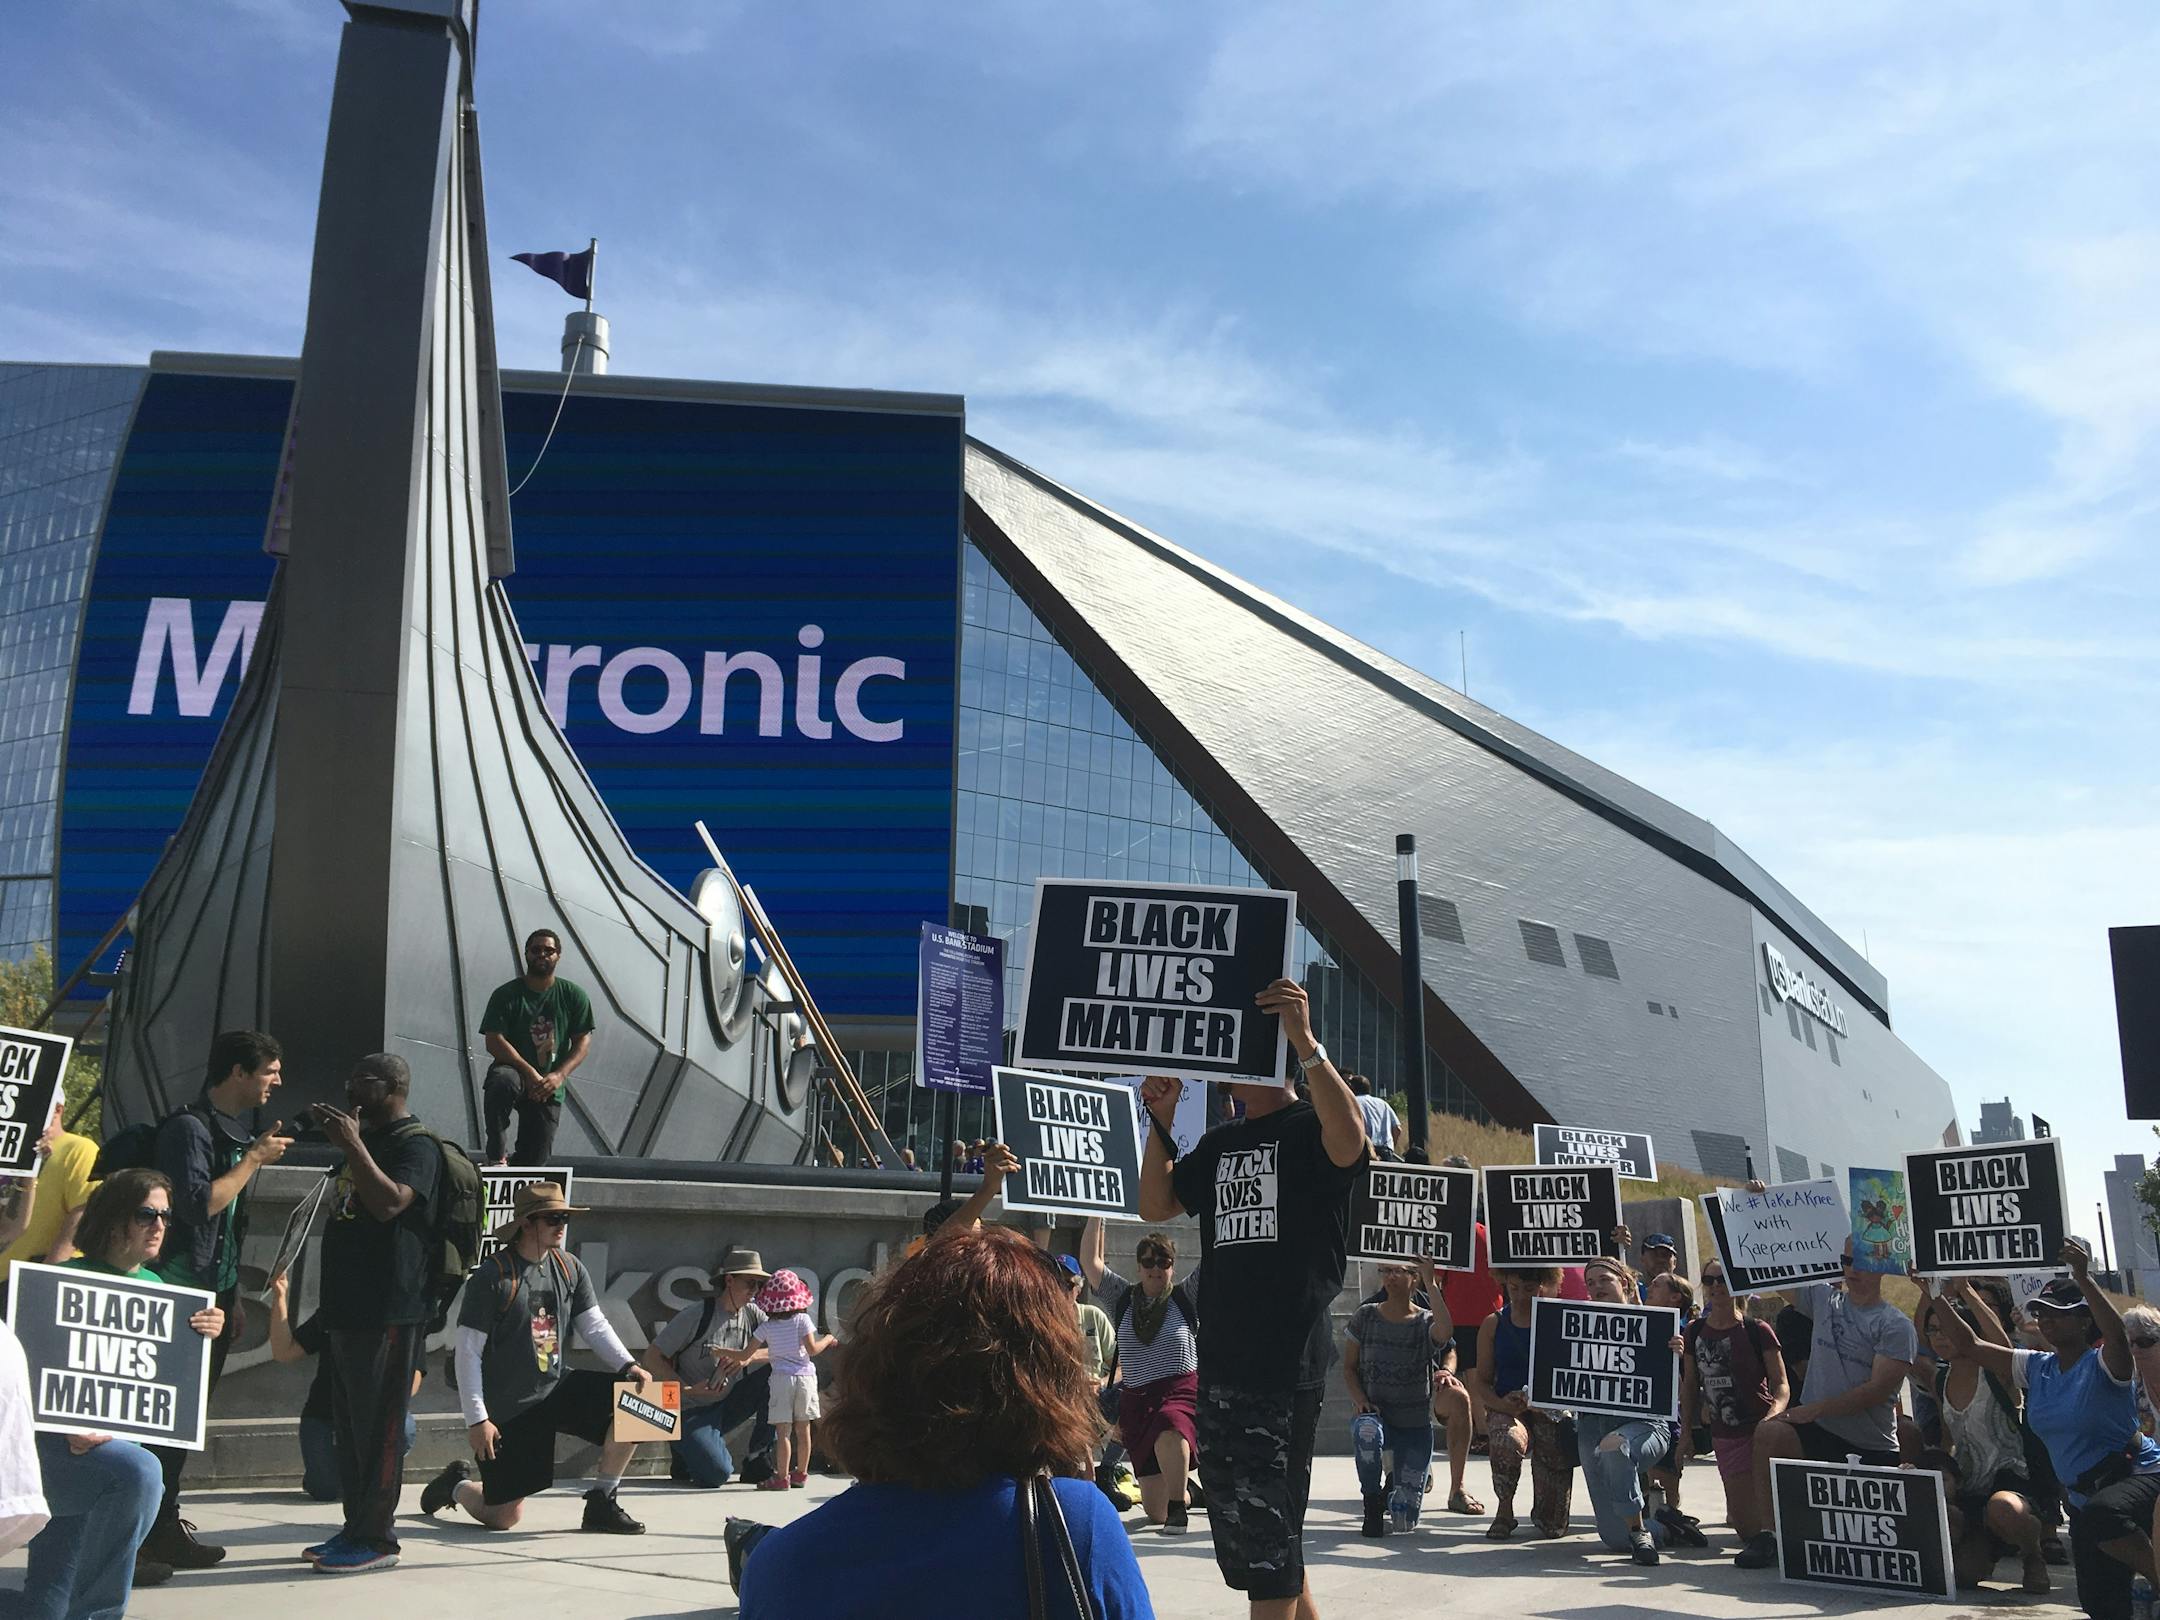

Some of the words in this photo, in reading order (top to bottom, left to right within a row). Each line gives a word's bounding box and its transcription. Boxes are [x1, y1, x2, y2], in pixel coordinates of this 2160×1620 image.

[127, 597, 906, 743] Mronic
[1089, 900, 1232, 951] BLACK
[931, 932, 944, 944] U.S.
[962, 940, 995, 955] STADIUM
[1096, 951, 1214, 1003] LIVES
[1064, 1002, 1236, 1059] MATTER
[1029, 1087, 1106, 1128] BLACK
[1040, 1124, 1105, 1165] LIVES
[1560, 1131, 1624, 1147] BLACK
[1567, 1142, 1621, 1159] LIVES
[1029, 1162, 1121, 1203] MATTER
[1371, 1172, 1445, 1202] BLACK
[1513, 1175, 1587, 1201] BLACK
[1938, 1156, 2026, 1192] BLACK
[1377, 1201, 1438, 1230] LIVES
[1521, 1203, 1584, 1229] LIVES
[1719, 1192, 1744, 1214] We
[1949, 1192, 2022, 1227] LIVES
[1753, 1214, 1792, 1232] with
[1362, 1226, 1450, 1259] MATTER
[1511, 1232, 1599, 1257] MATTER
[1938, 1227, 2040, 1262] MATTER
[2021, 1277, 2044, 1296] Colin
[61, 1286, 169, 1338] BLACK
[1564, 1312, 1643, 1344] BLACK
[68, 1330, 158, 1380] LIVES
[1570, 1341, 1636, 1374] LIVES
[44, 1372, 172, 1427] MATTER
[1555, 1370, 1649, 1405] MATTER
[621, 1393, 640, 1412] BLACK
[638, 1402, 655, 1419] LIVES
[652, 1409, 675, 1429] MATTER
[1809, 1476, 1903, 1513] BLACK
[1821, 1510, 1898, 1547] LIVES
[1807, 1543, 1918, 1584] MATTER
